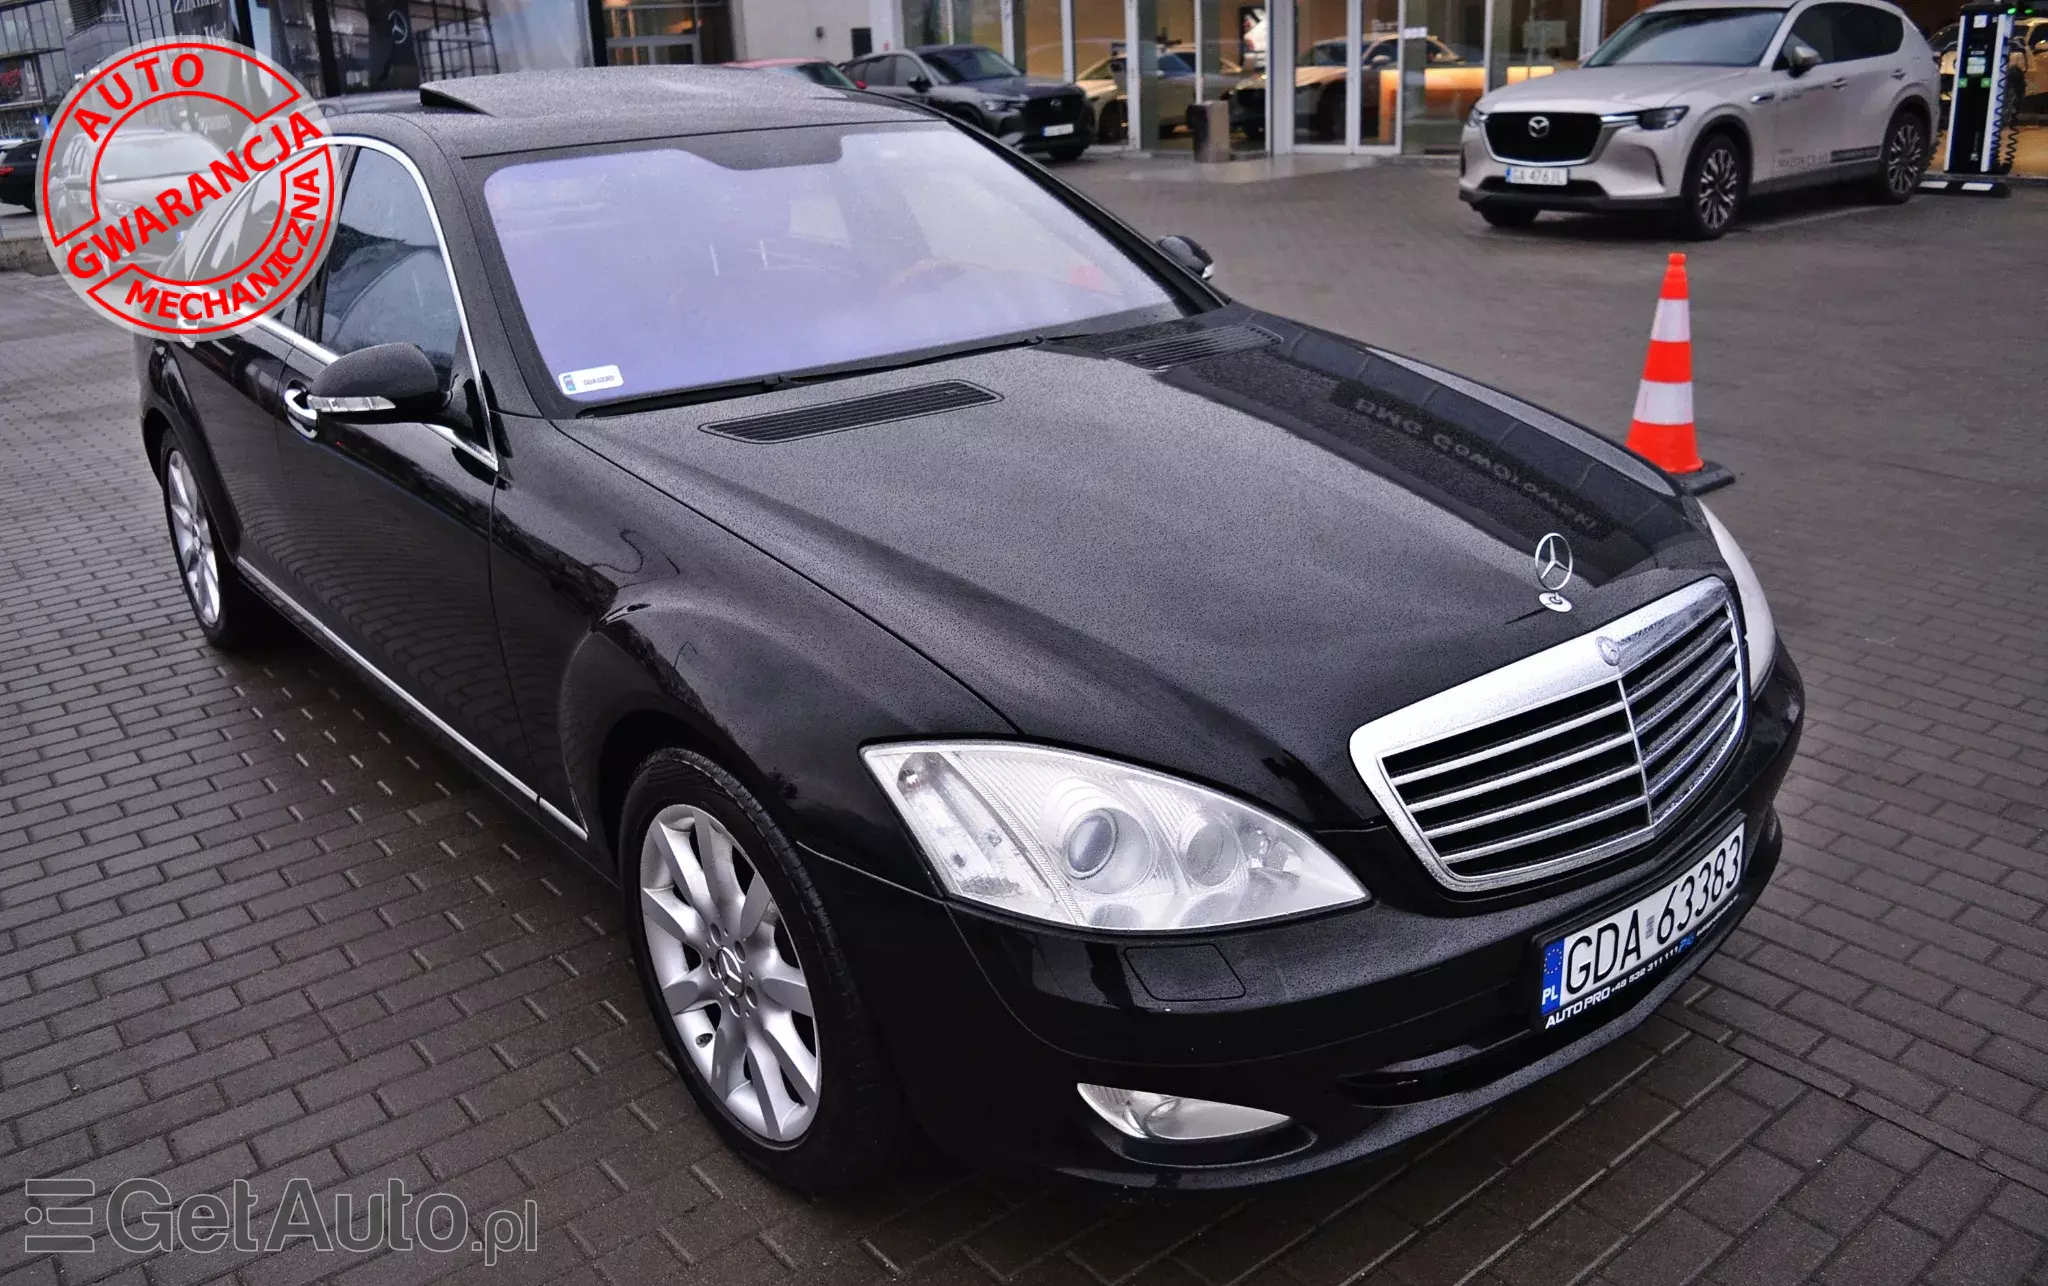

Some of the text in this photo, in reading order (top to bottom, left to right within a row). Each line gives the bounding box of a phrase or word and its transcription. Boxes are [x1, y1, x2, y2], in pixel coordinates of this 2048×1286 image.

[1566, 908, 1642, 995] GDA
[1656, 835, 1741, 945] 63383
[1541, 987, 1559, 1006] PL
[1545, 1002, 1583, 1030] AUTO
[1583, 986, 1611, 1010] PRO
